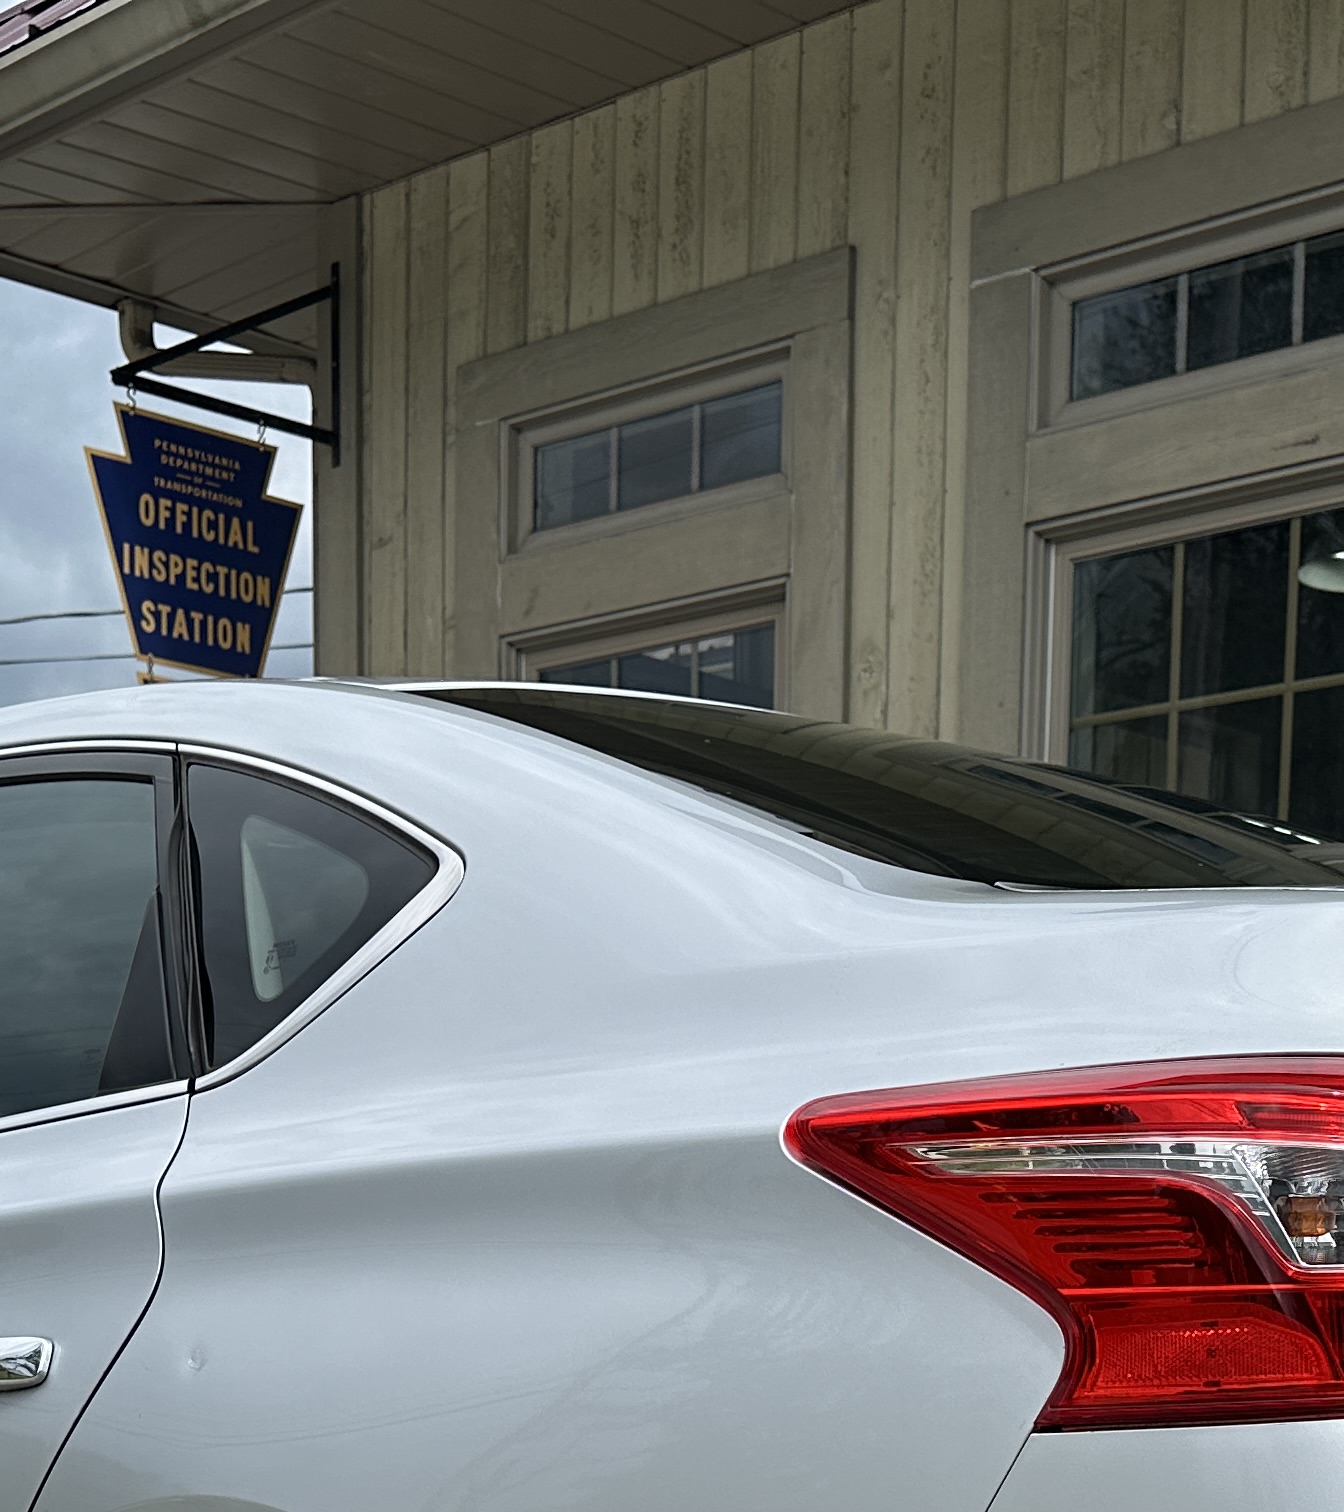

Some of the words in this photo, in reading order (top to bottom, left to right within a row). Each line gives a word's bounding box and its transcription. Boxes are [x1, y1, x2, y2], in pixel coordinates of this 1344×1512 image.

[154, 438, 240, 471] PENNSYLVANIA
[160, 453, 235, 482] DEPARTMENT
[153, 475, 243, 508] TRANSPORTATION
[138, 493, 260, 554] OFFICIAL
[122, 542, 271, 608] INSPECTION
[140, 600, 251, 655] STATION
